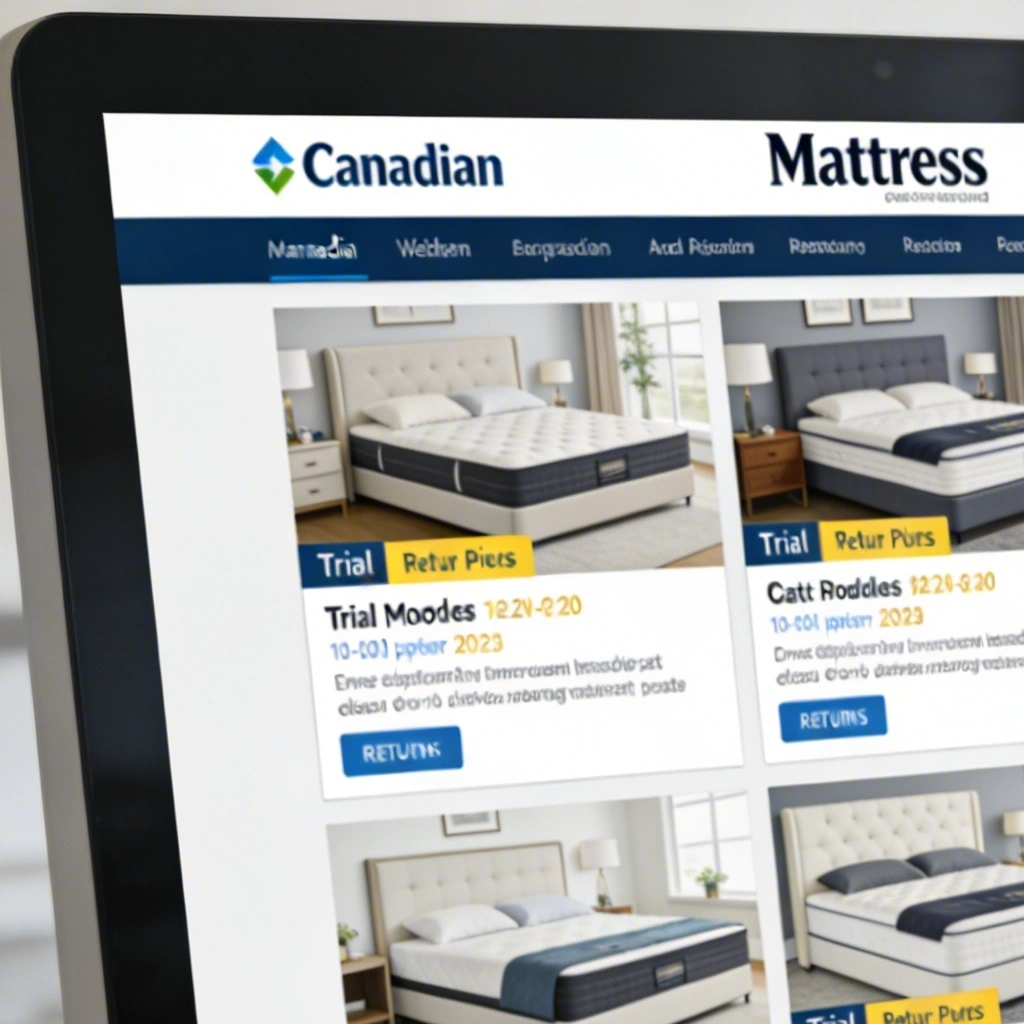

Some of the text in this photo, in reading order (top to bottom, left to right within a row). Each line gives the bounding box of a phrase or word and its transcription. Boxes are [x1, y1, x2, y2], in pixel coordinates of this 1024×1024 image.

[302, 142, 503, 187] Canadian
[765, 133, 988, 186] Mattress
[759, 529, 809, 556] Trial
[317, 550, 374, 578] Trial
[324, 602, 377, 630] Trial
[879, 606, 924, 628] 2023
[454, 633, 503, 654] 2023
